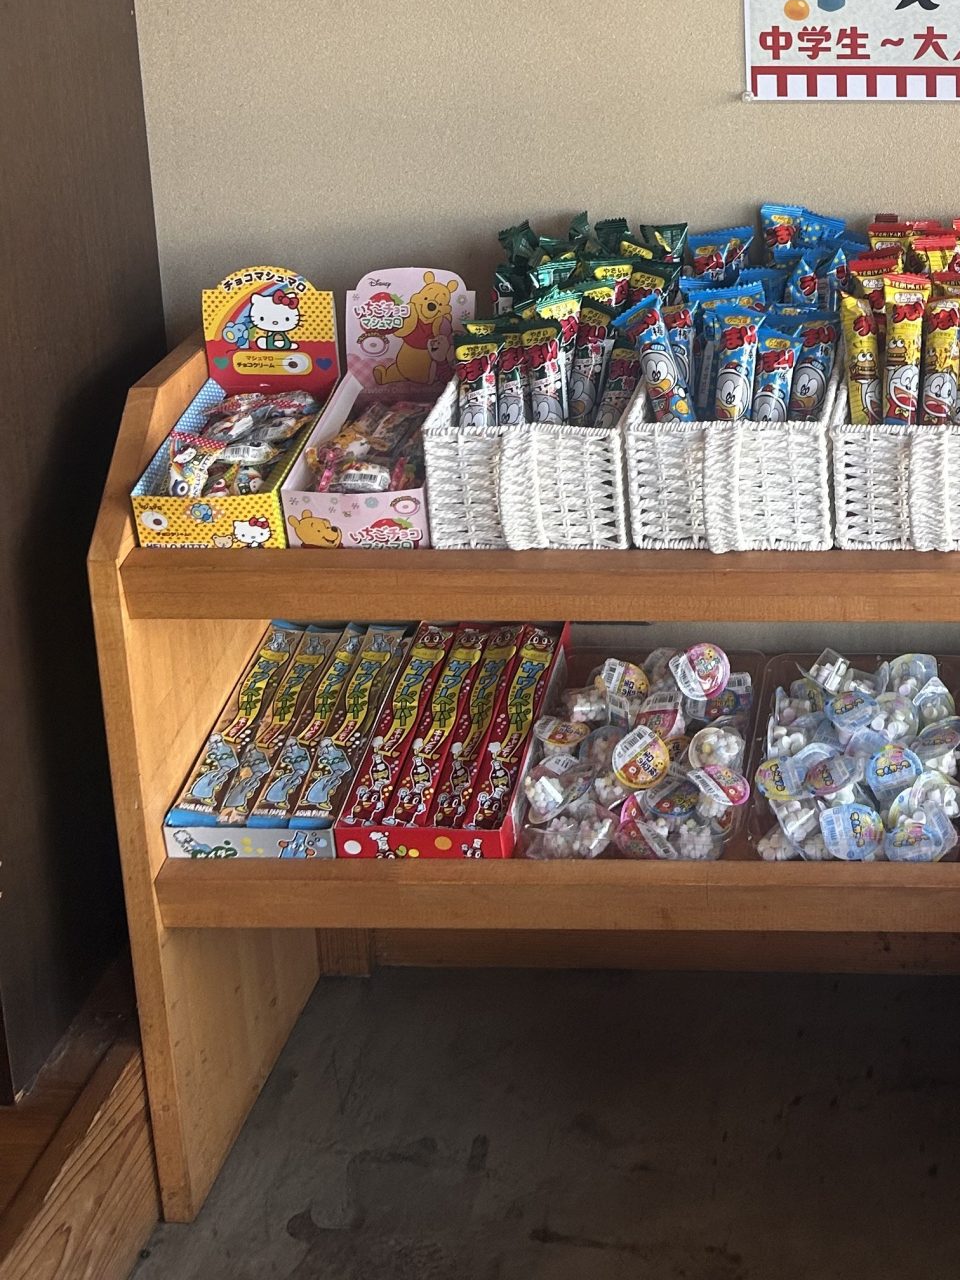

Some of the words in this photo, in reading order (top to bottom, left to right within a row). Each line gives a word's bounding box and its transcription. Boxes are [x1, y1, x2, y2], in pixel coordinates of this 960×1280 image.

[223, 270, 307, 293] チョコマシュマロ
[354, 301, 411, 318] いちごチョコ
[361, 317, 403, 328] マシュマロ
[350, 527, 422, 543] いちごチョコ
[394, 659, 434, 727] サワーペーパー
[432, 659, 472, 729] サワーペーパー
[510, 660, 547, 731] サワーペーパー
